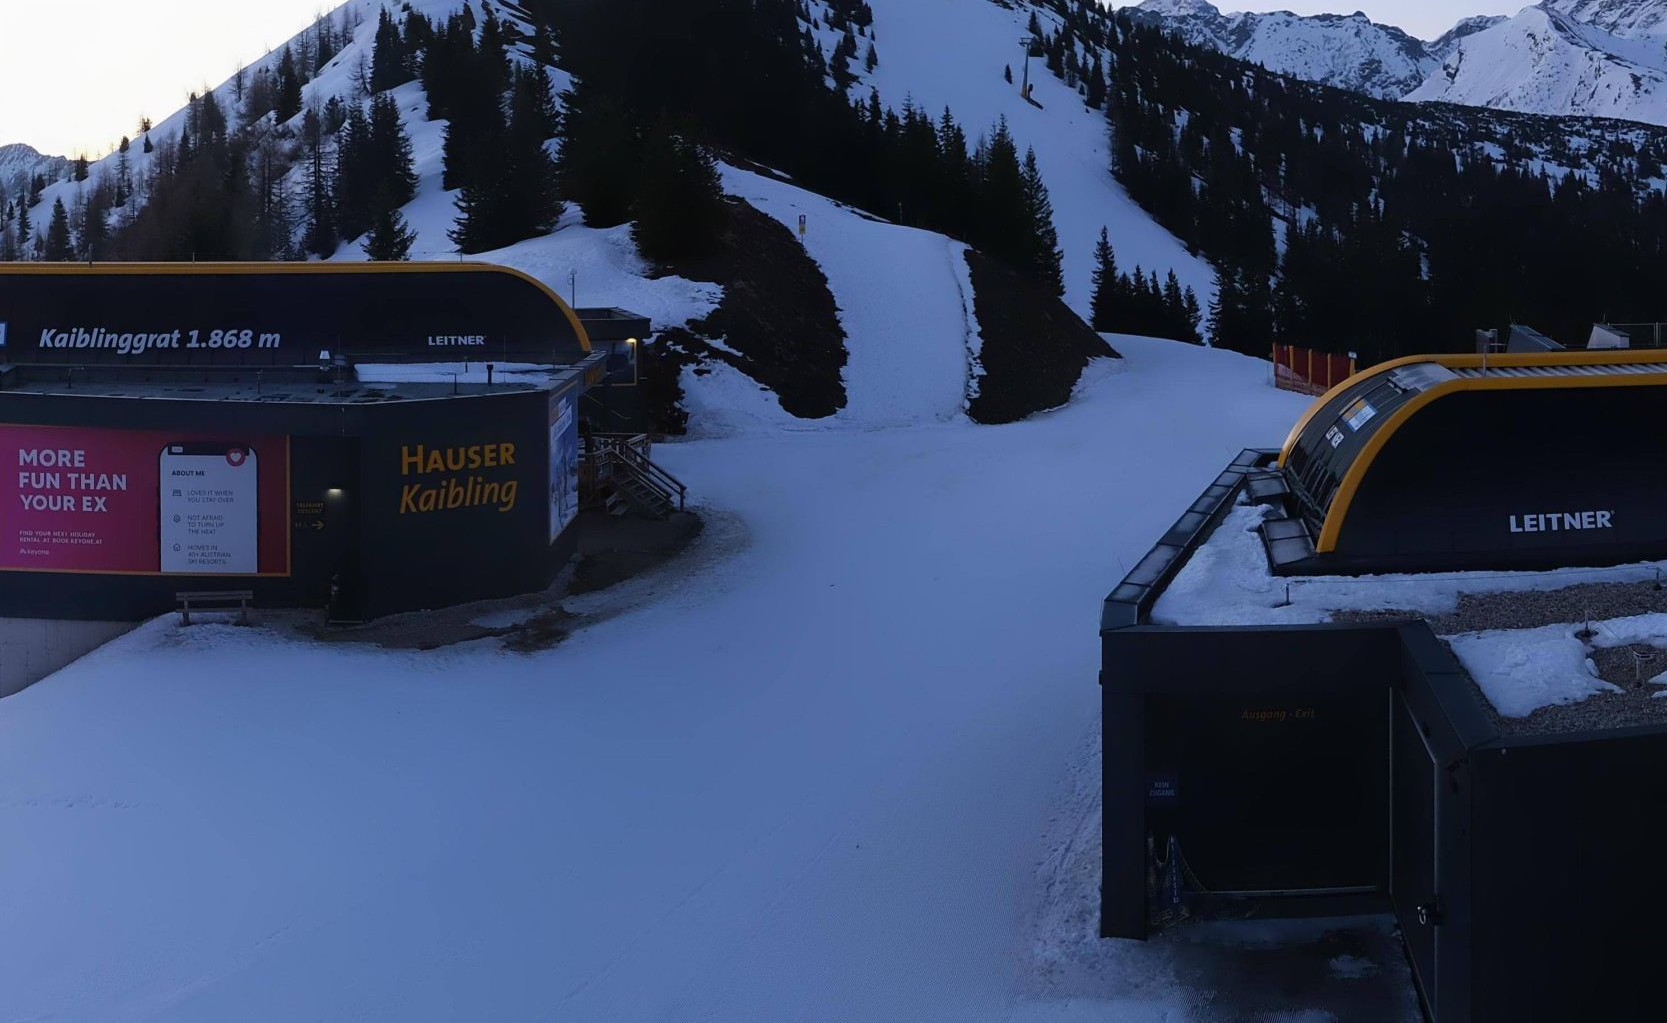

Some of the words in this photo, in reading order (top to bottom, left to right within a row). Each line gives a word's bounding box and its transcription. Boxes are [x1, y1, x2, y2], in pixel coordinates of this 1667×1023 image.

[39, 328, 180, 354] Kaiblinggrat
[186, 330, 252, 348] 1.868
[259, 333, 280, 348] m
[428, 335, 485, 346] LEITNER
[19, 449, 86, 468] MORE
[401, 442, 516, 476] HAUSER
[19, 472, 60, 489] FUN
[68, 473, 127, 490] THAN
[20, 494, 76, 511] YOUR
[82, 496, 108, 512] EX
[400, 476, 518, 514] Kaibling
[1510, 510, 1612, 532] LEITNER
[1242, 710, 1286, 721] Ausgang
[1295, 708, 1315, 718] Exit
